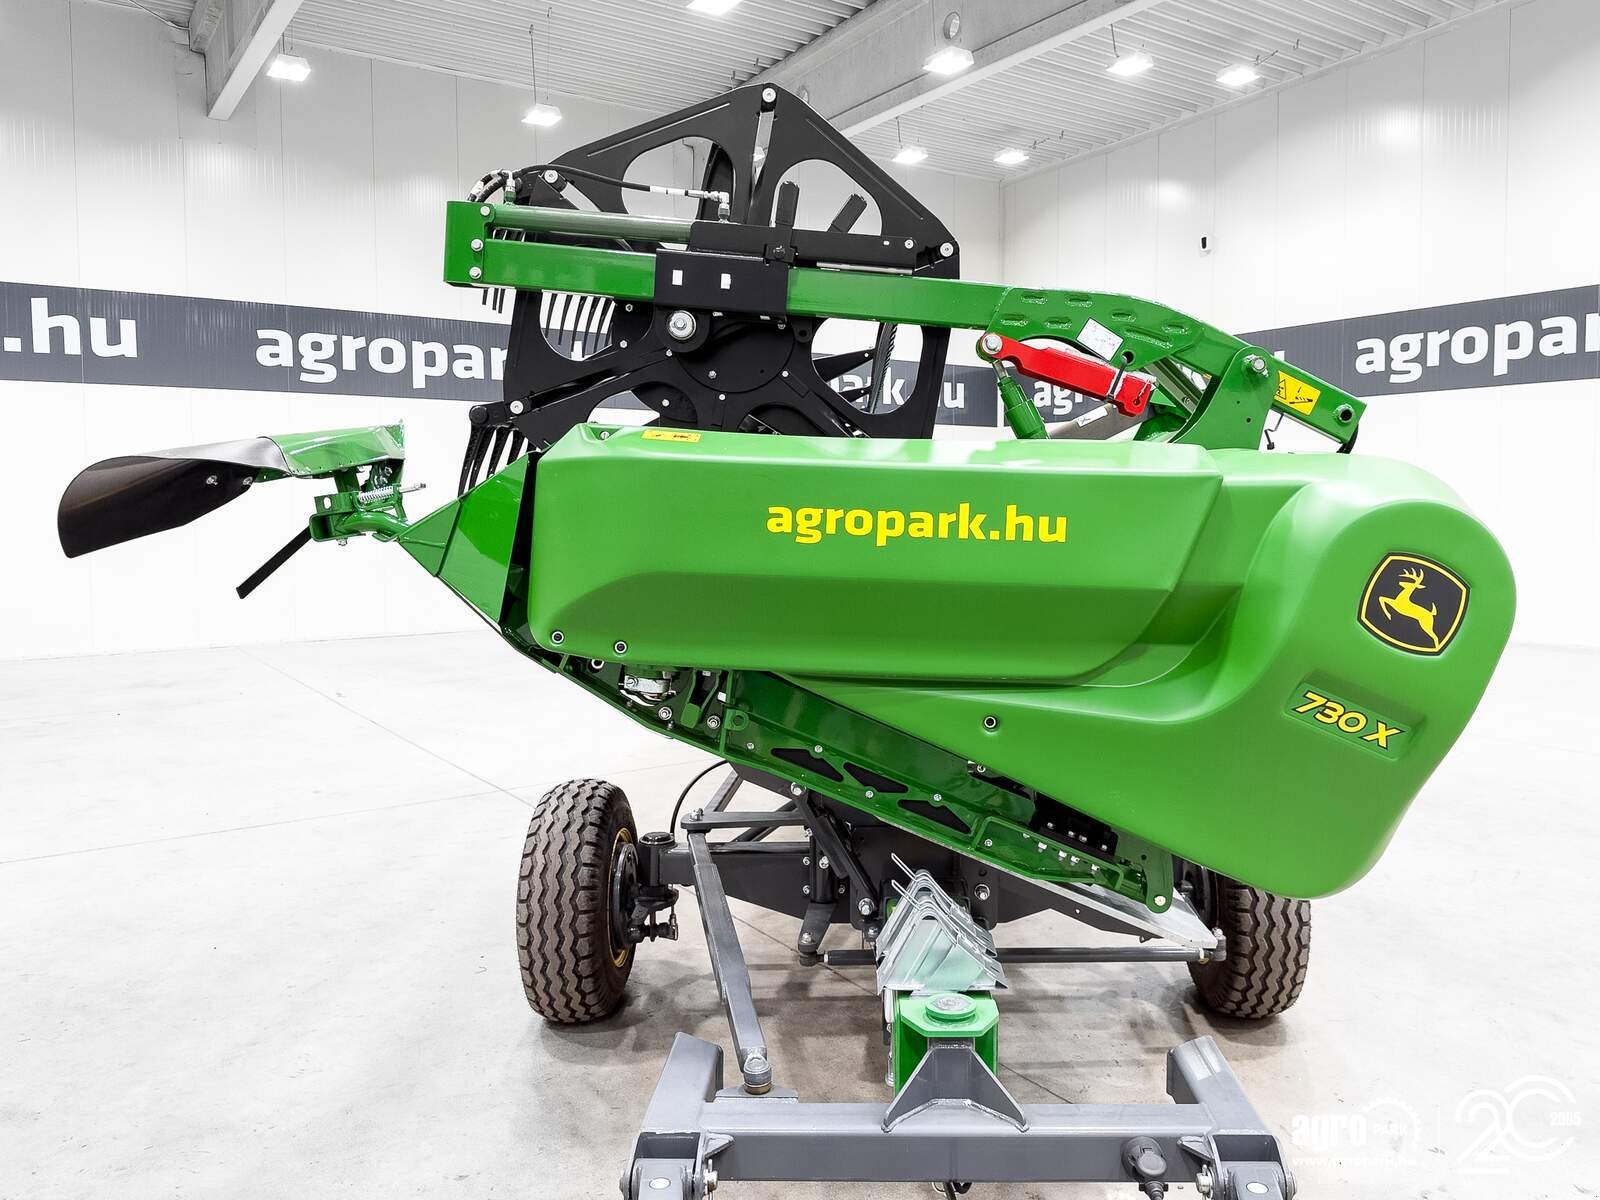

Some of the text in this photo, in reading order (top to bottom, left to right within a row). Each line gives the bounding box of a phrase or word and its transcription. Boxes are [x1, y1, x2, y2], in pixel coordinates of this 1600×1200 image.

[3, 297, 138, 358] .hu
[766, 502, 1068, 547] agropark.hu
[1292, 690, 1405, 749] 730 X
